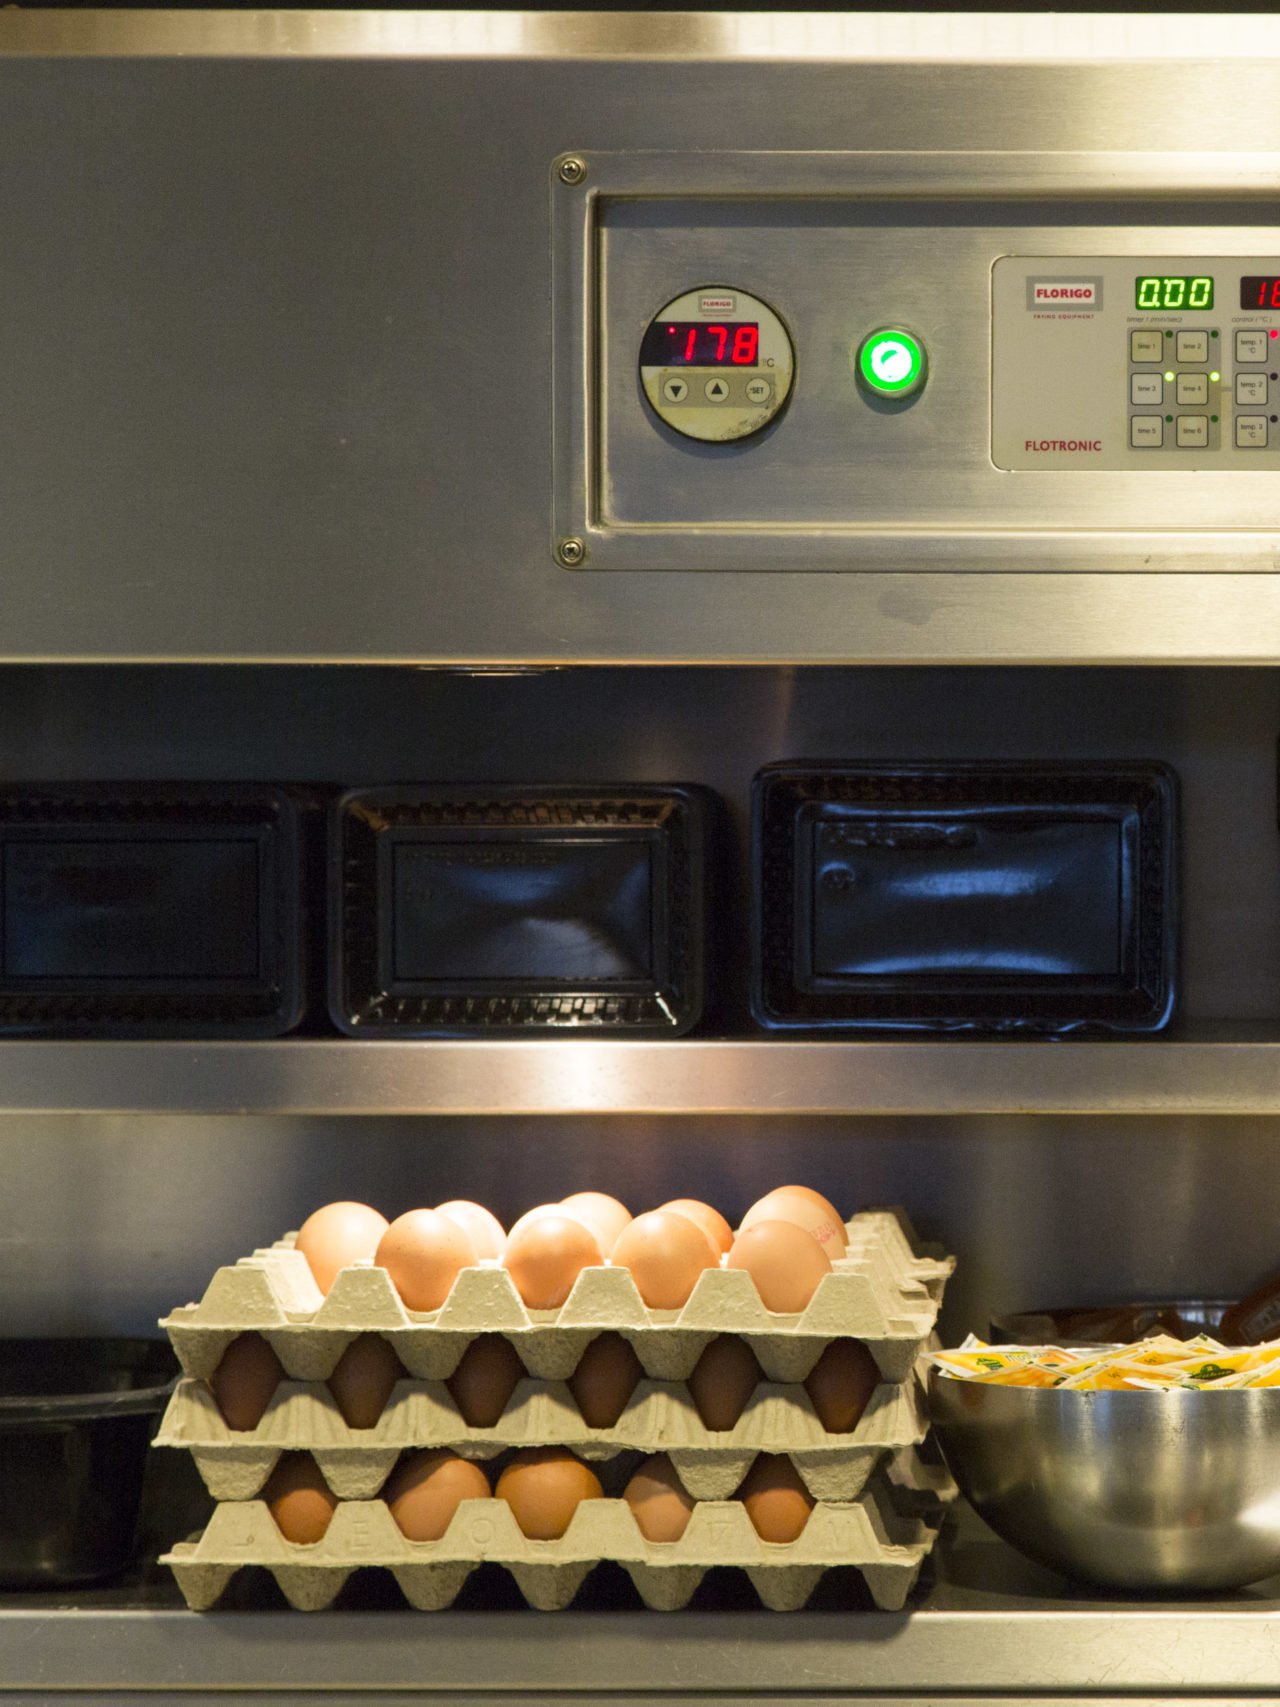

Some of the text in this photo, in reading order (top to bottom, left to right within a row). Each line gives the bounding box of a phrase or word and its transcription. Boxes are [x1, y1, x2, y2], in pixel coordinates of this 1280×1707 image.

[1036, 288, 1092, 299] FLORIGO
[685, 326, 759, 363] 178
[1025, 440, 1102, 451] FLOTRONIC
